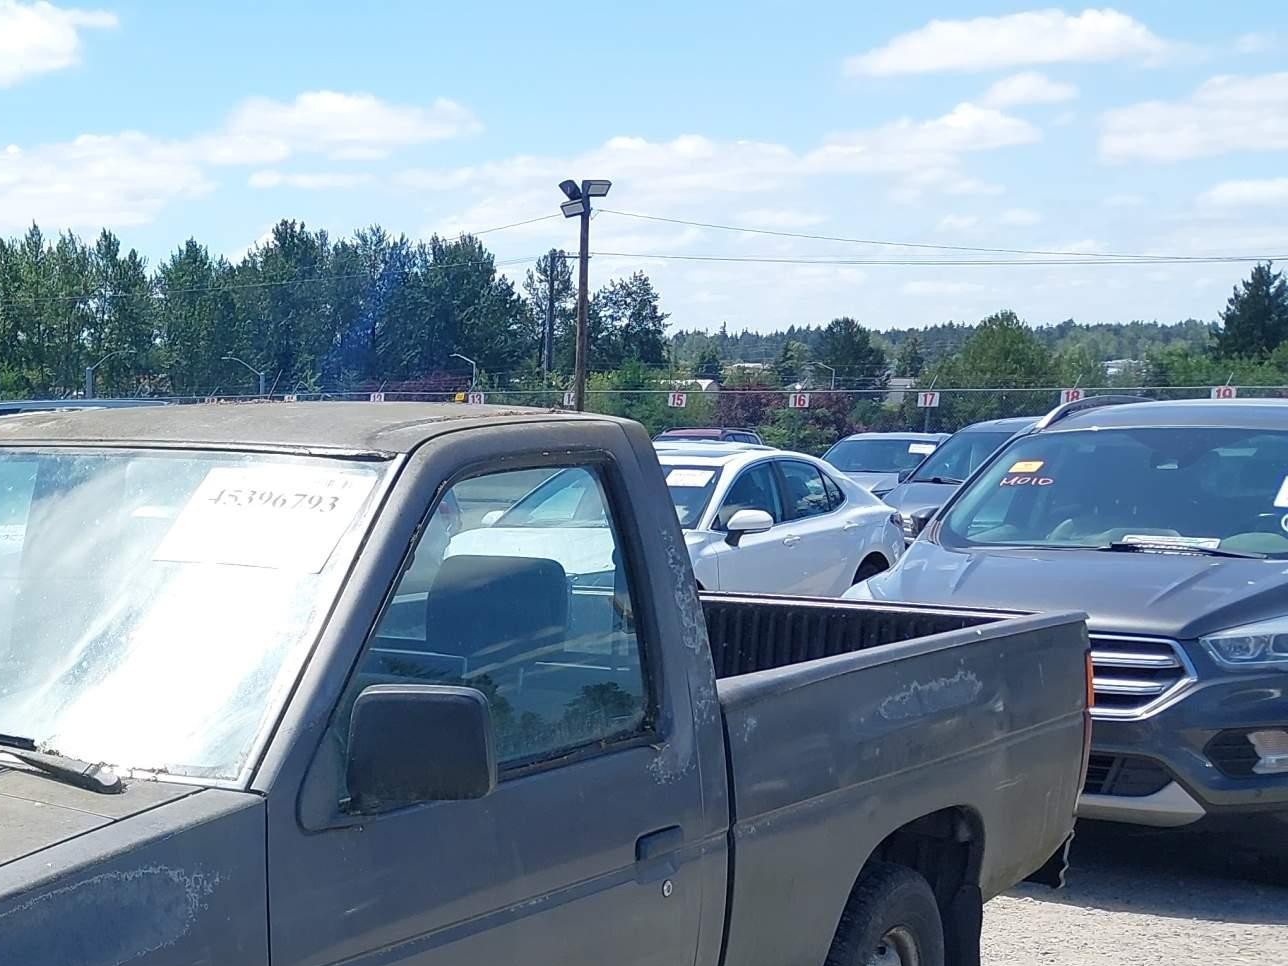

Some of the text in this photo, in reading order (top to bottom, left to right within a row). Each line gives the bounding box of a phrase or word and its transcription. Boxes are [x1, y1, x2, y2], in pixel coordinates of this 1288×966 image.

[671, 394, 683, 406] 15
[793, 394, 806, 406] 16
[923, 394, 935, 405] 17
[1064, 390, 1080, 402] 18
[208, 488, 340, 513] 45396793
